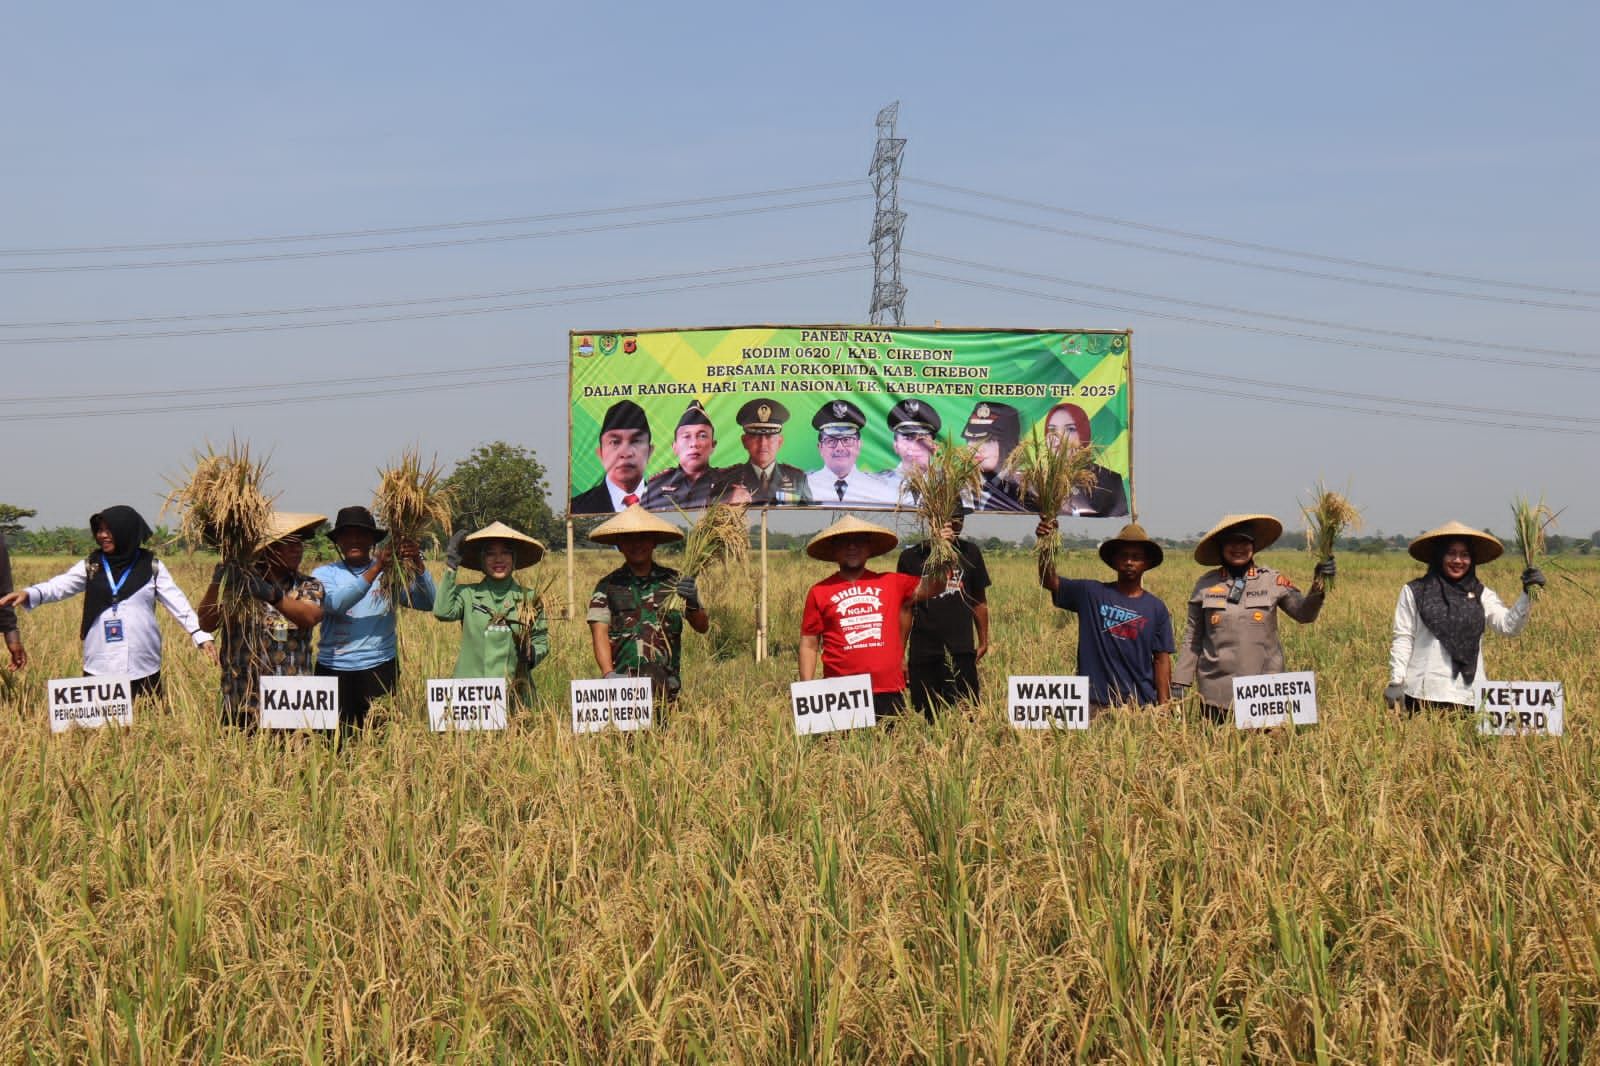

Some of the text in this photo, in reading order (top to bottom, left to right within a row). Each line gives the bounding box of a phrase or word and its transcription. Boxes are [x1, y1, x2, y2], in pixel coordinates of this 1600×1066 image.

[801, 331, 892, 343] PANEN RAYA
[742, 347, 953, 361] KODIM 0620 / KAB. CIREBON
[706, 364, 989, 379] BERSAMA FORKOPIMDA KAB. CIREBON
[583, 381, 1117, 398] DALAM RANGKA HARI TANI NASIONAL TK. KABUPATEN CIREBON TH. 2025
[830, 585, 884, 604] SHOLAT
[847, 606, 873, 616] NGAJI
[54, 683, 126, 705] KETUA
[431, 685, 503, 702] IBU KETUA
[576, 687, 617, 704] DANDIM
[1016, 683, 1081, 699] WAKIL
[1236, 681, 1311, 700] KAPOLRESTA
[1481, 687, 1556, 706] KETUA
[264, 689, 335, 711] KAJARI
[796, 689, 870, 717] BUPATI
[1250, 700, 1301, 717] CIREBON
[54, 703, 129, 721] PENGADILAN NEGERI
[576, 705, 650, 723] KAB.CREBON
[1014, 705, 1084, 722] BUPATI
